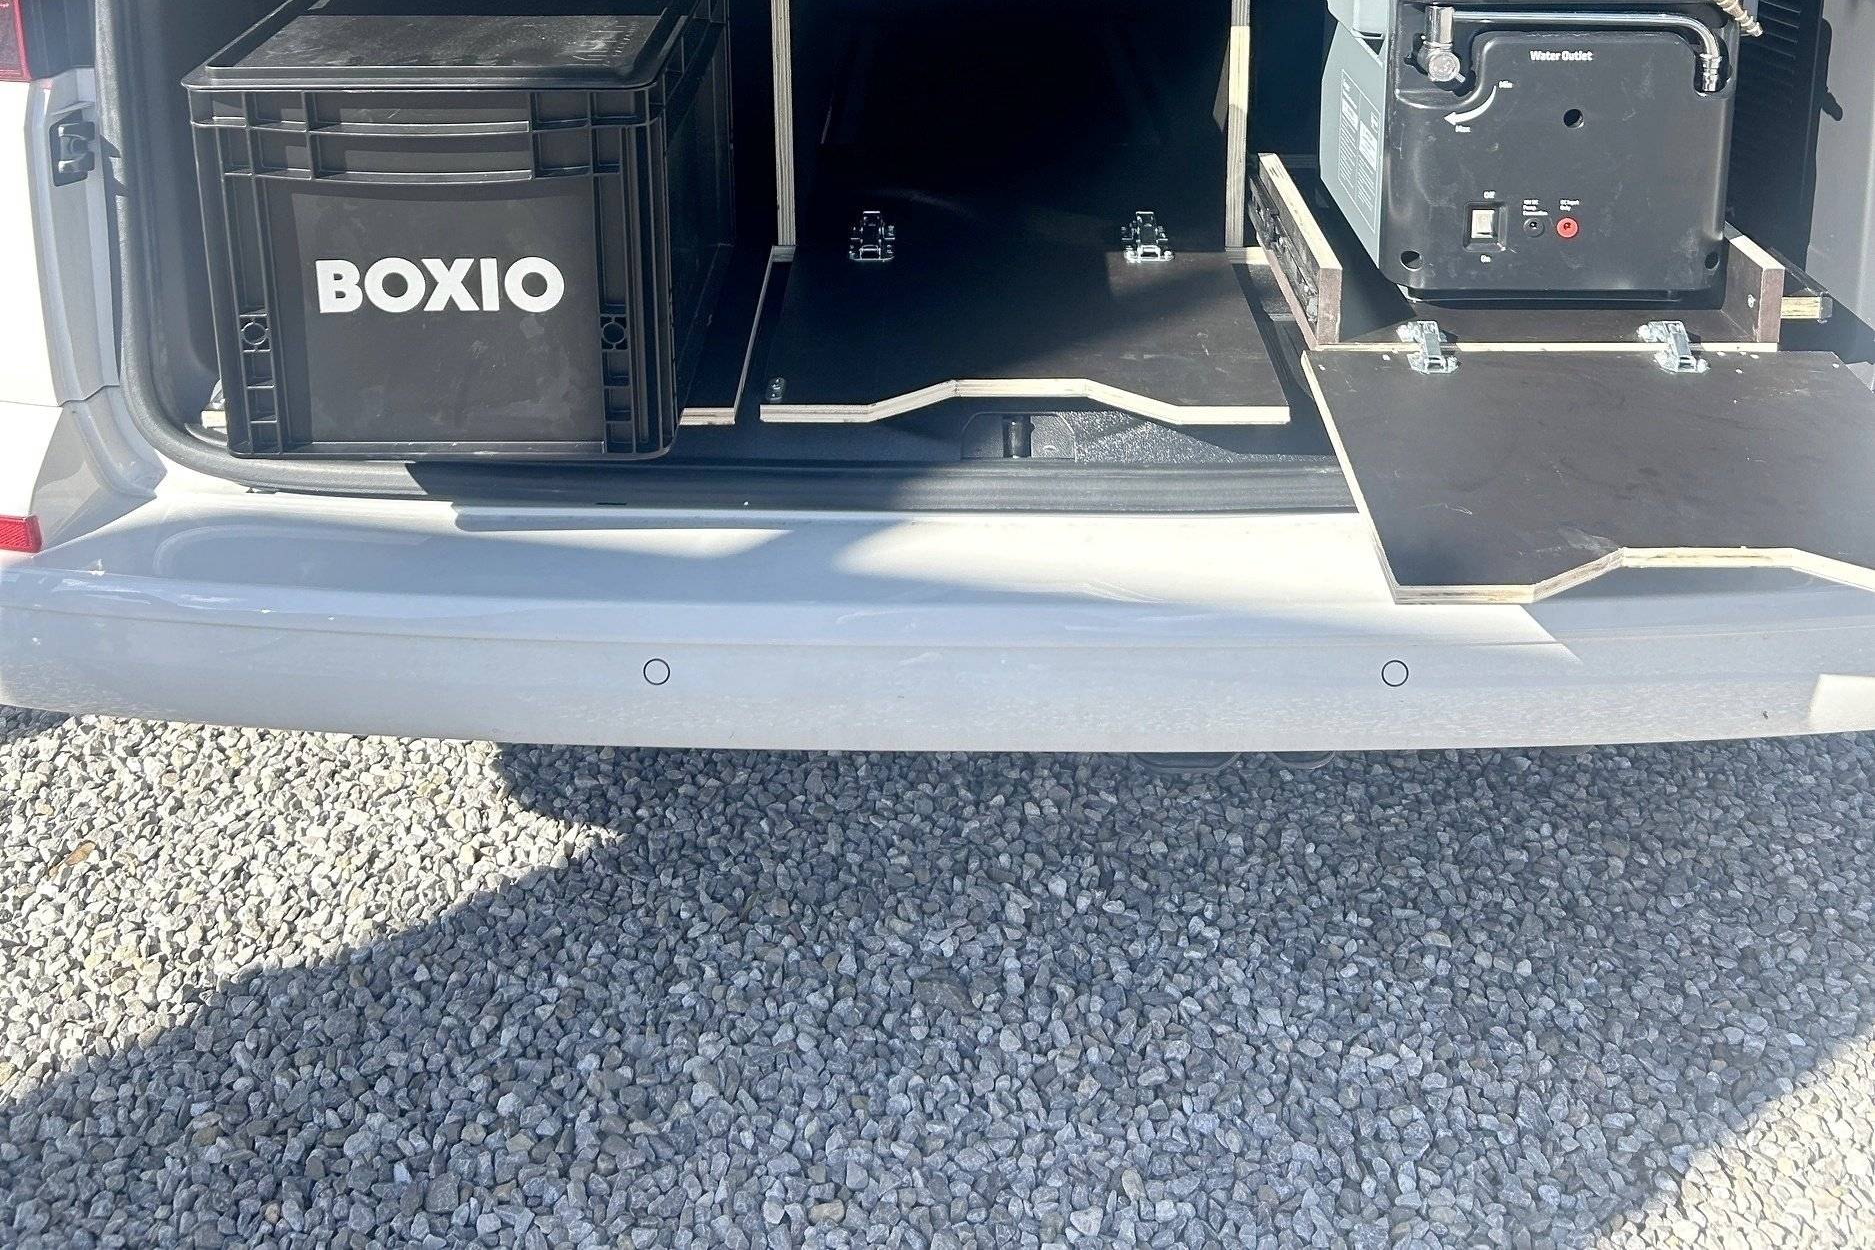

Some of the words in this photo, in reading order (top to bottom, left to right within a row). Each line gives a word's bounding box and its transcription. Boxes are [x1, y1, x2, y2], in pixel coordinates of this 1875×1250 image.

[1530, 50, 1561, 61] Water
[1561, 50, 1593, 61] Outlet
[315, 256, 565, 314] BOXIO
